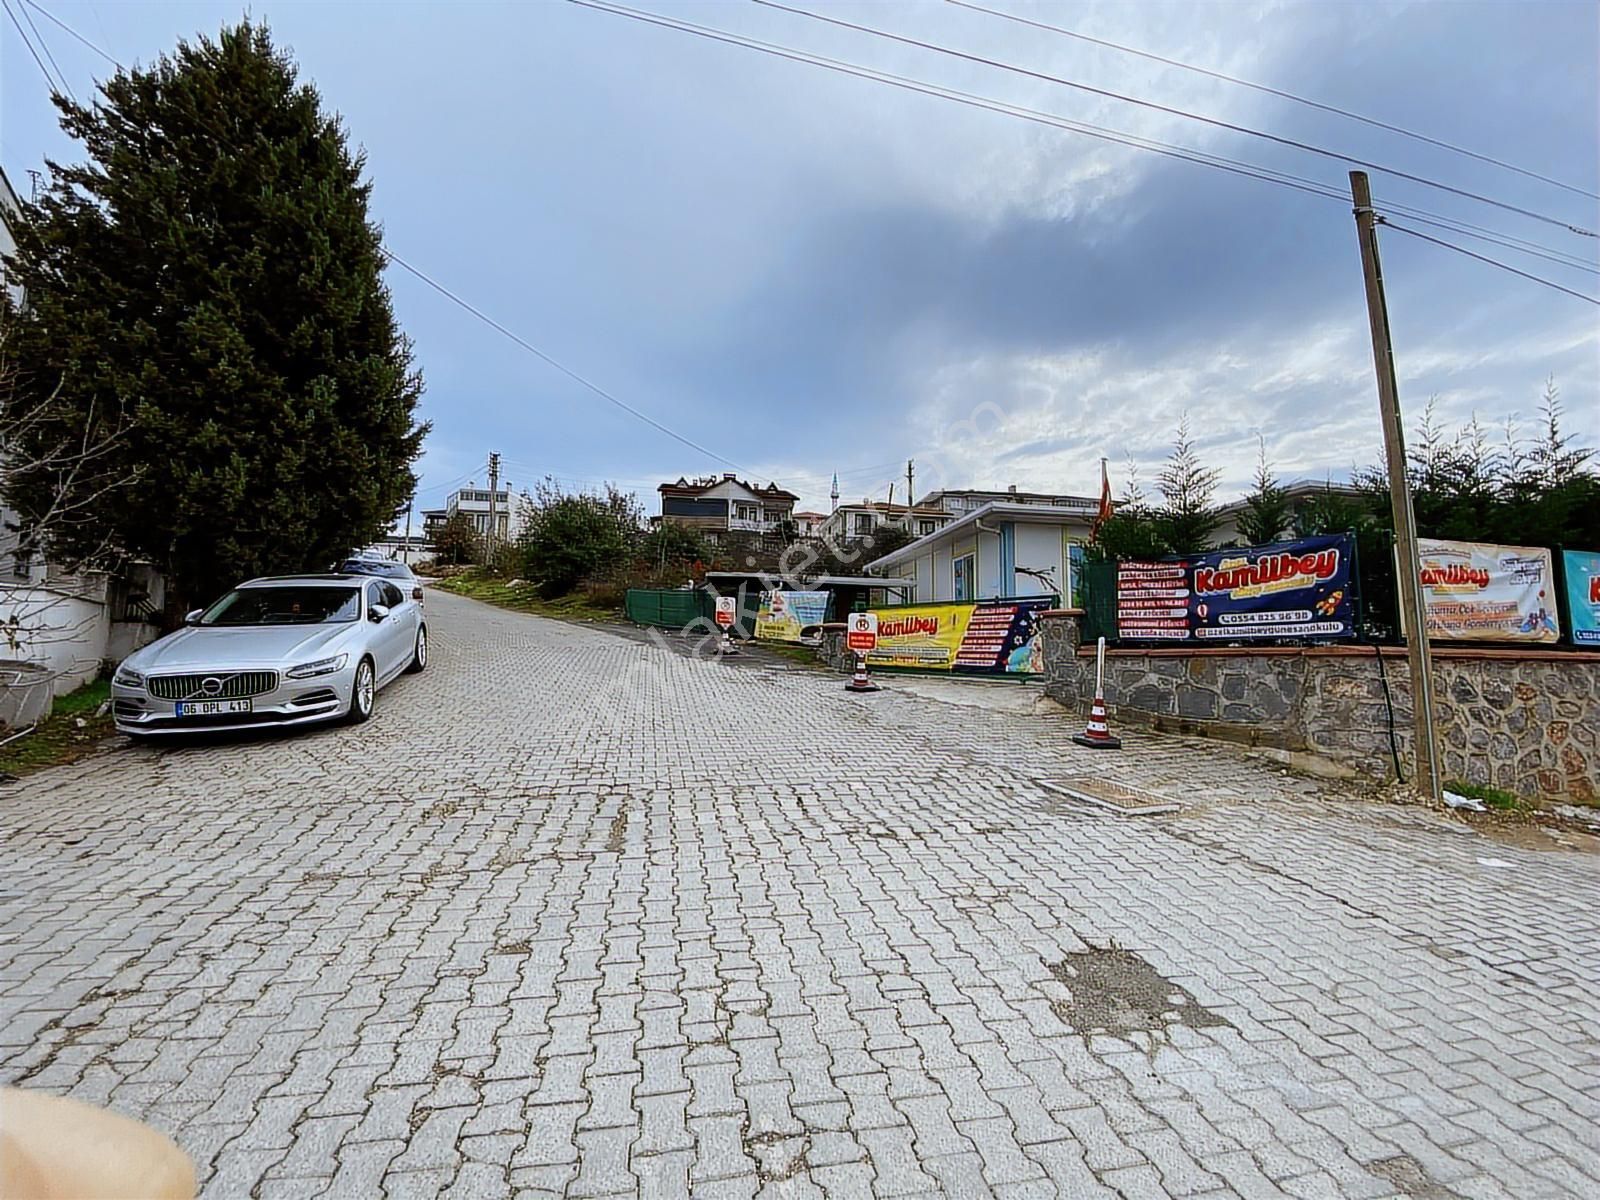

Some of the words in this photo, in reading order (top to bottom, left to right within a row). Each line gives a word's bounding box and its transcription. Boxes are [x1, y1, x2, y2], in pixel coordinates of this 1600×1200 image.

[1195, 549, 1338, 594] Kamilbey
[1420, 563, 1489, 588] amilbey
[877, 616, 938, 637] Kamilbey
[183, 703, 197, 714] 06
[229, 700, 249, 712] 413
